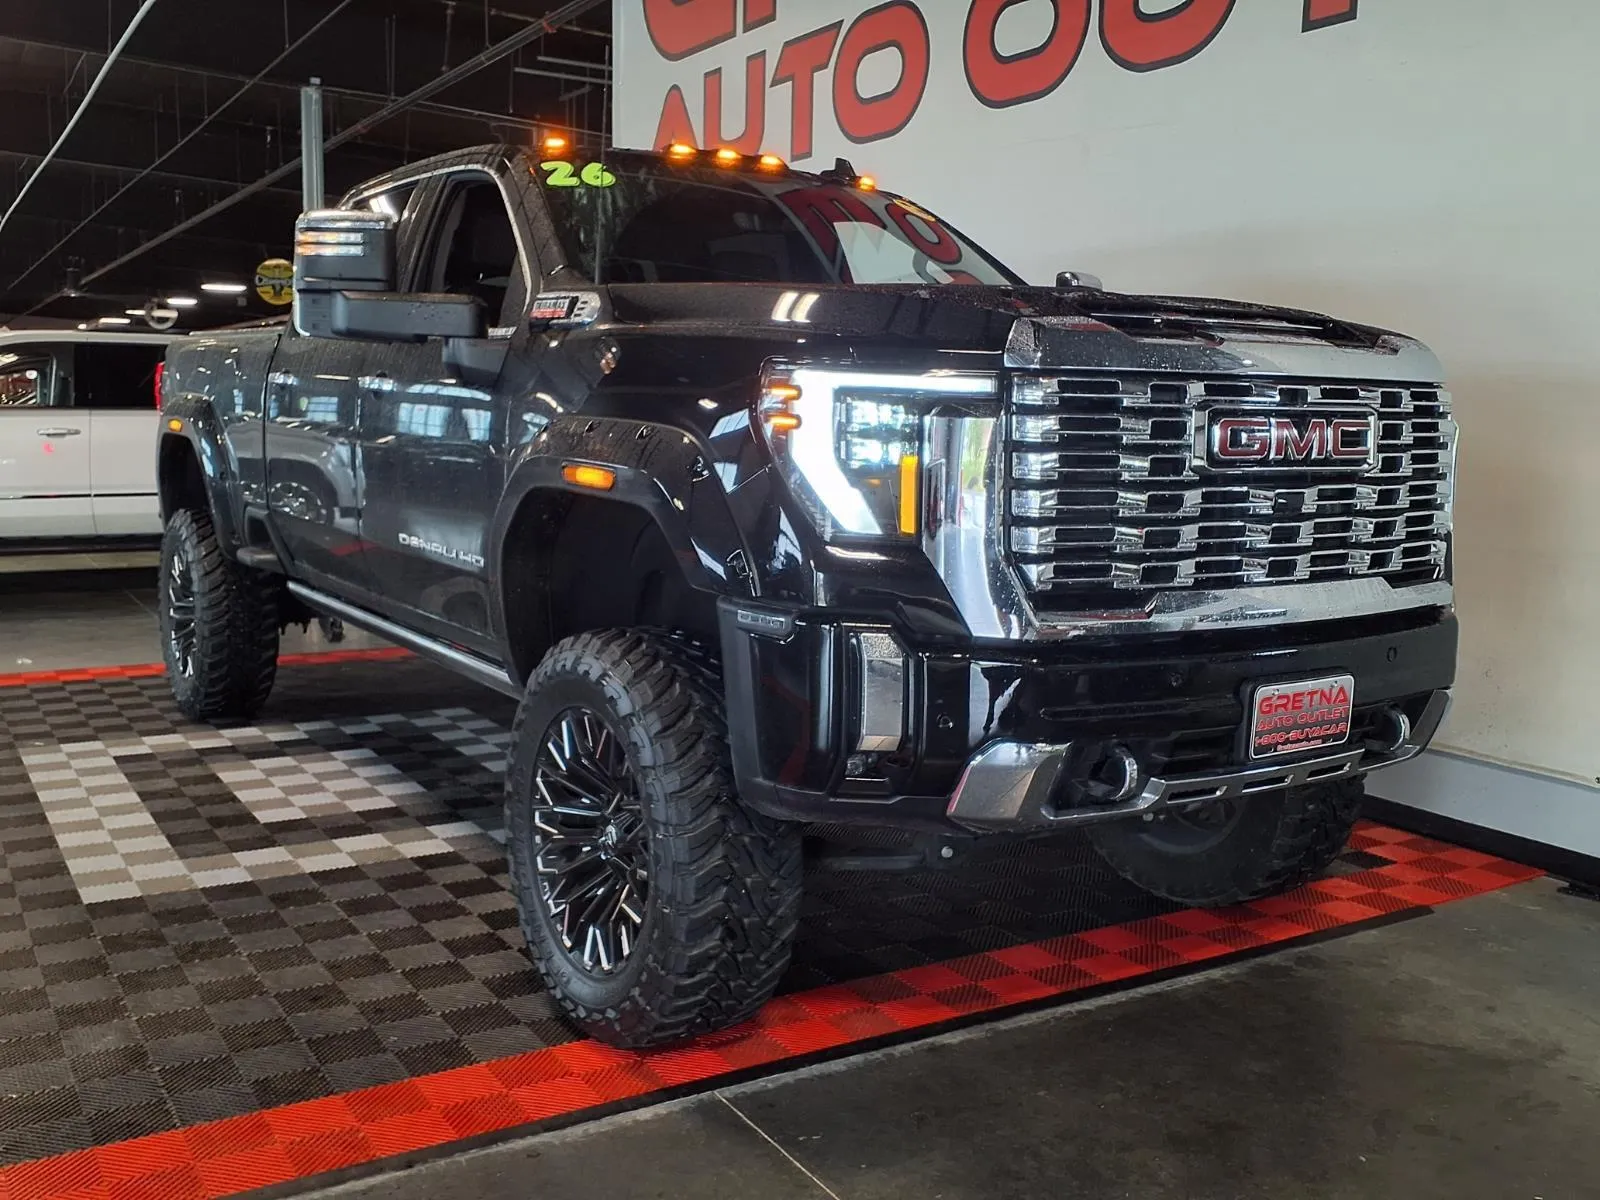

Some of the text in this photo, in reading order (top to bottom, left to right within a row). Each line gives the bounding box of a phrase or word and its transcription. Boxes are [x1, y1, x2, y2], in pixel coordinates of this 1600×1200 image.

[651, 0, 930, 163] AUTO
[540, 161, 616, 187] 26
[1217, 417, 1372, 459] GMC
[1259, 685, 1349, 715] GRETNA
[1256, 706, 1351, 732] AUTO OUTLET
